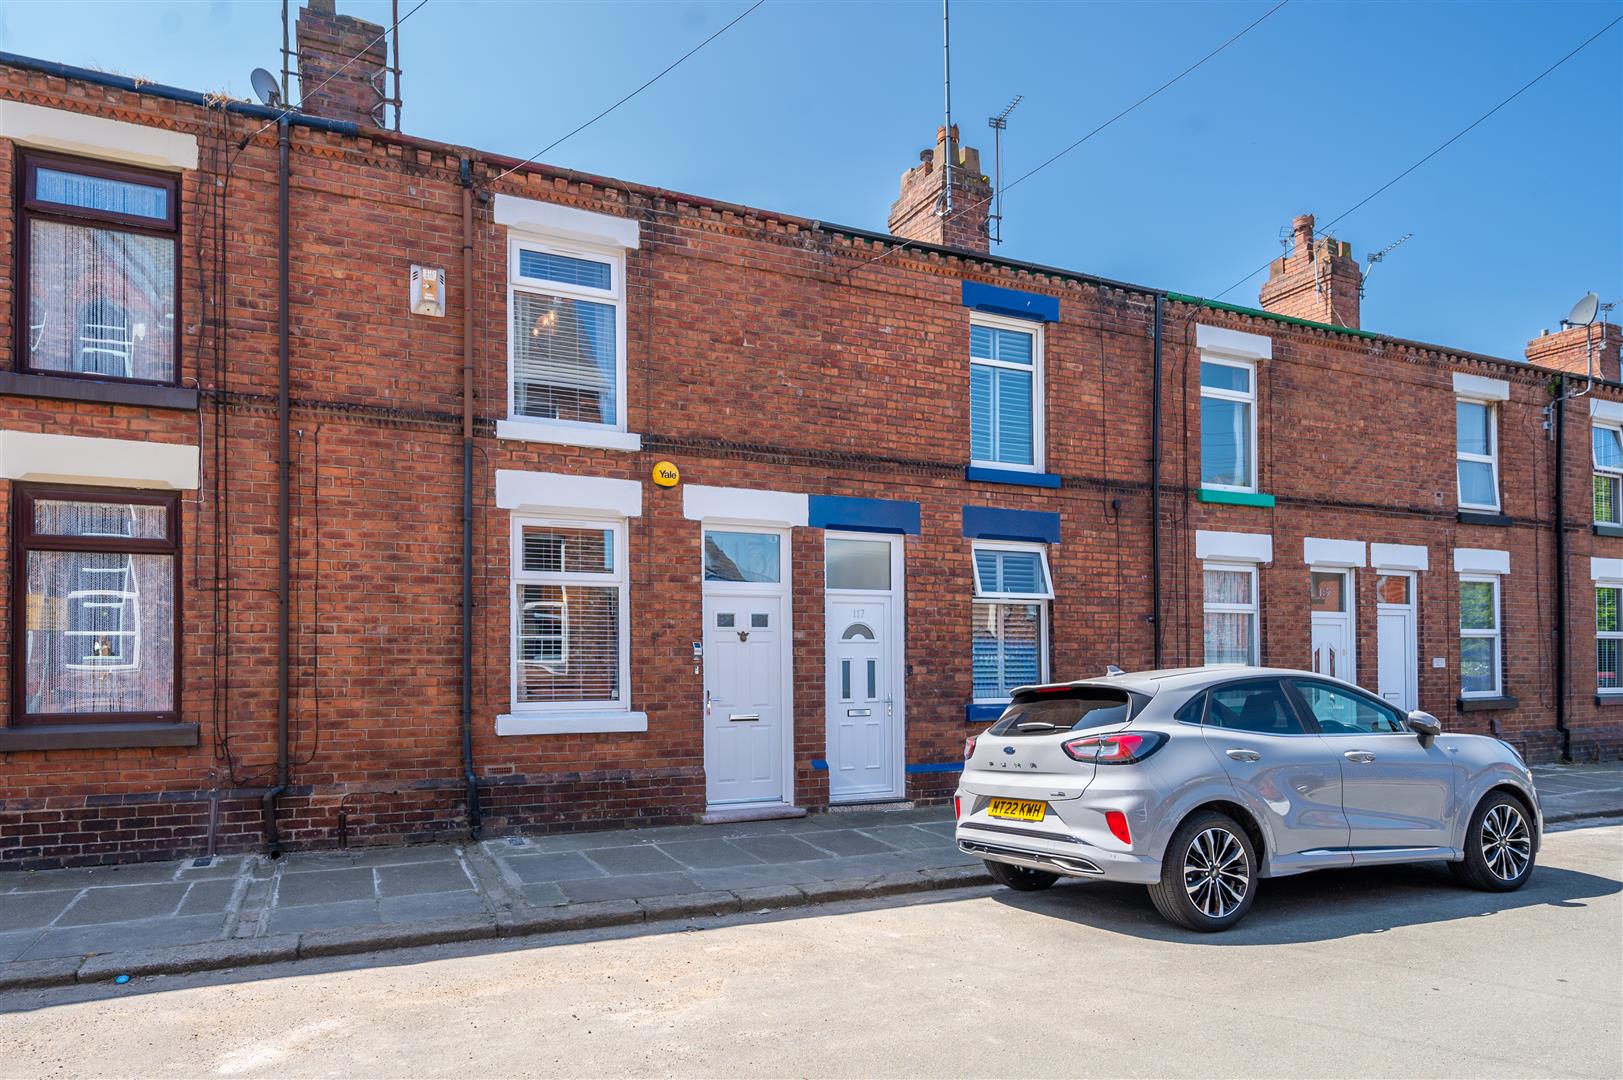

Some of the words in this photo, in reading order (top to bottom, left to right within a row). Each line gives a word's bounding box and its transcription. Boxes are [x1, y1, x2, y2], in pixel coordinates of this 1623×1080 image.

[659, 470, 677, 480] Yale
[852, 608, 865, 618] 117
[1018, 802, 1042, 817] KWH
